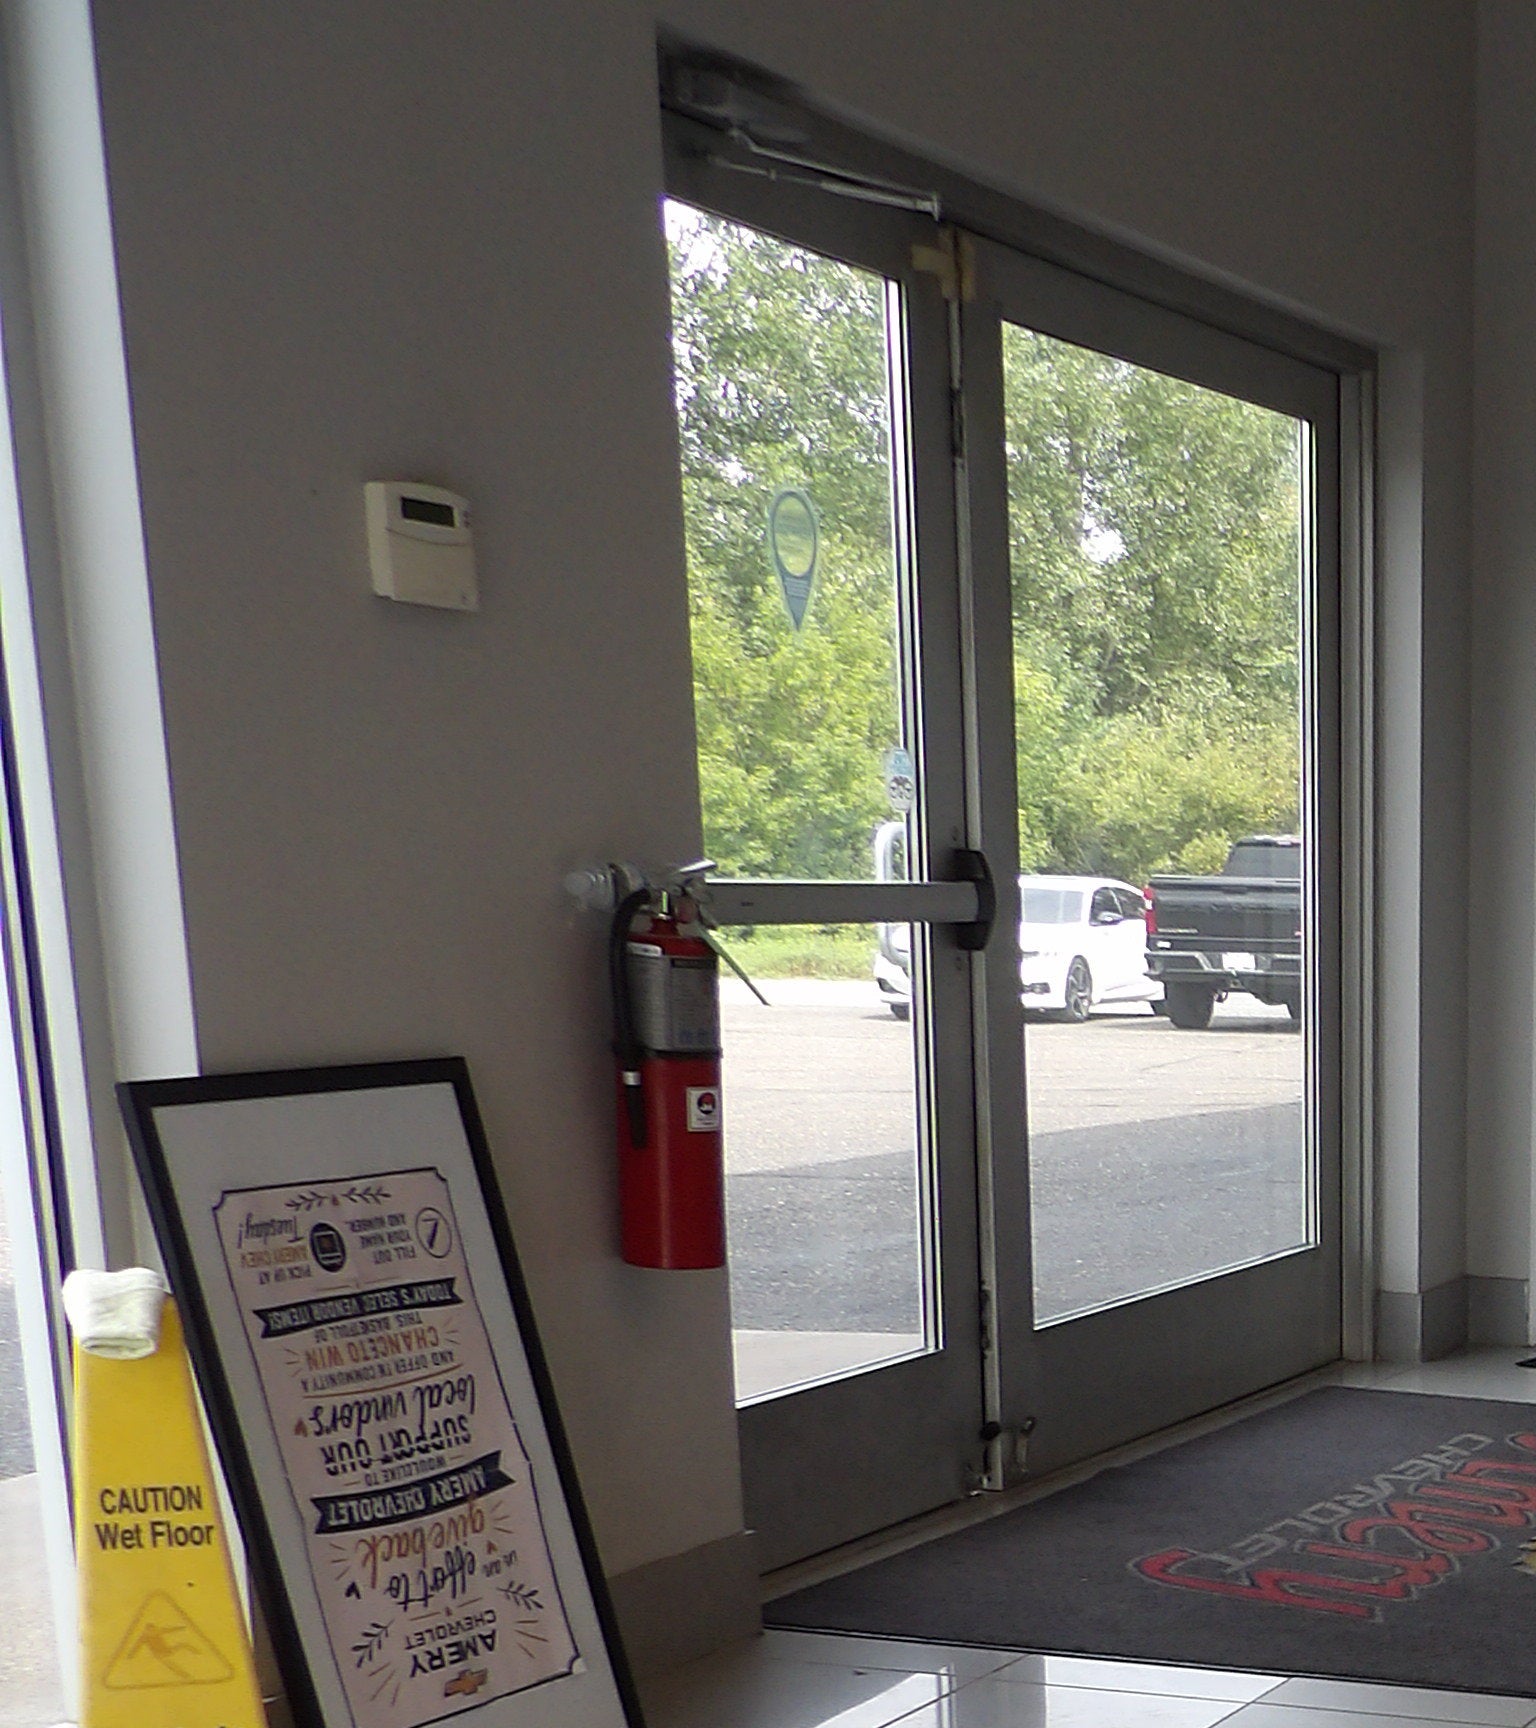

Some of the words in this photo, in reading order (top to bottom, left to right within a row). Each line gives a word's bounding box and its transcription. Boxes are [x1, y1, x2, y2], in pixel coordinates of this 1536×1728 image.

[305, 1346, 344, 1371] WIN
[348, 1341, 369, 1363] TO
[369, 1326, 439, 1359] CHANCE
[431, 1351, 453, 1366] AND
[312, 1367, 375, 1390] COMMUNITY
[394, 1354, 427, 1372] OFFER
[412, 1374, 475, 1431] local
[379, 1415, 471, 1465] SUPPORT
[320, 1439, 372, 1476] OUR
[364, 1473, 379, 1486] TO
[429, 1465, 486, 1506] AMERY
[99, 1484, 204, 1516] CAUTION
[328, 1488, 425, 1525] CHEVROLET
[1203, 1432, 1497, 1574] CHEVROLET
[94, 1521, 144, 1551] Wet
[150, 1519, 215, 1549] Floor
[483, 1560, 501, 1577] an
[502, 1551, 517, 1568] in
[384, 1573, 411, 1612] to
[417, 1546, 475, 1607] effort
[405, 1610, 496, 1650] CHEVROLET
[410, 1630, 496, 1678] AMERY
